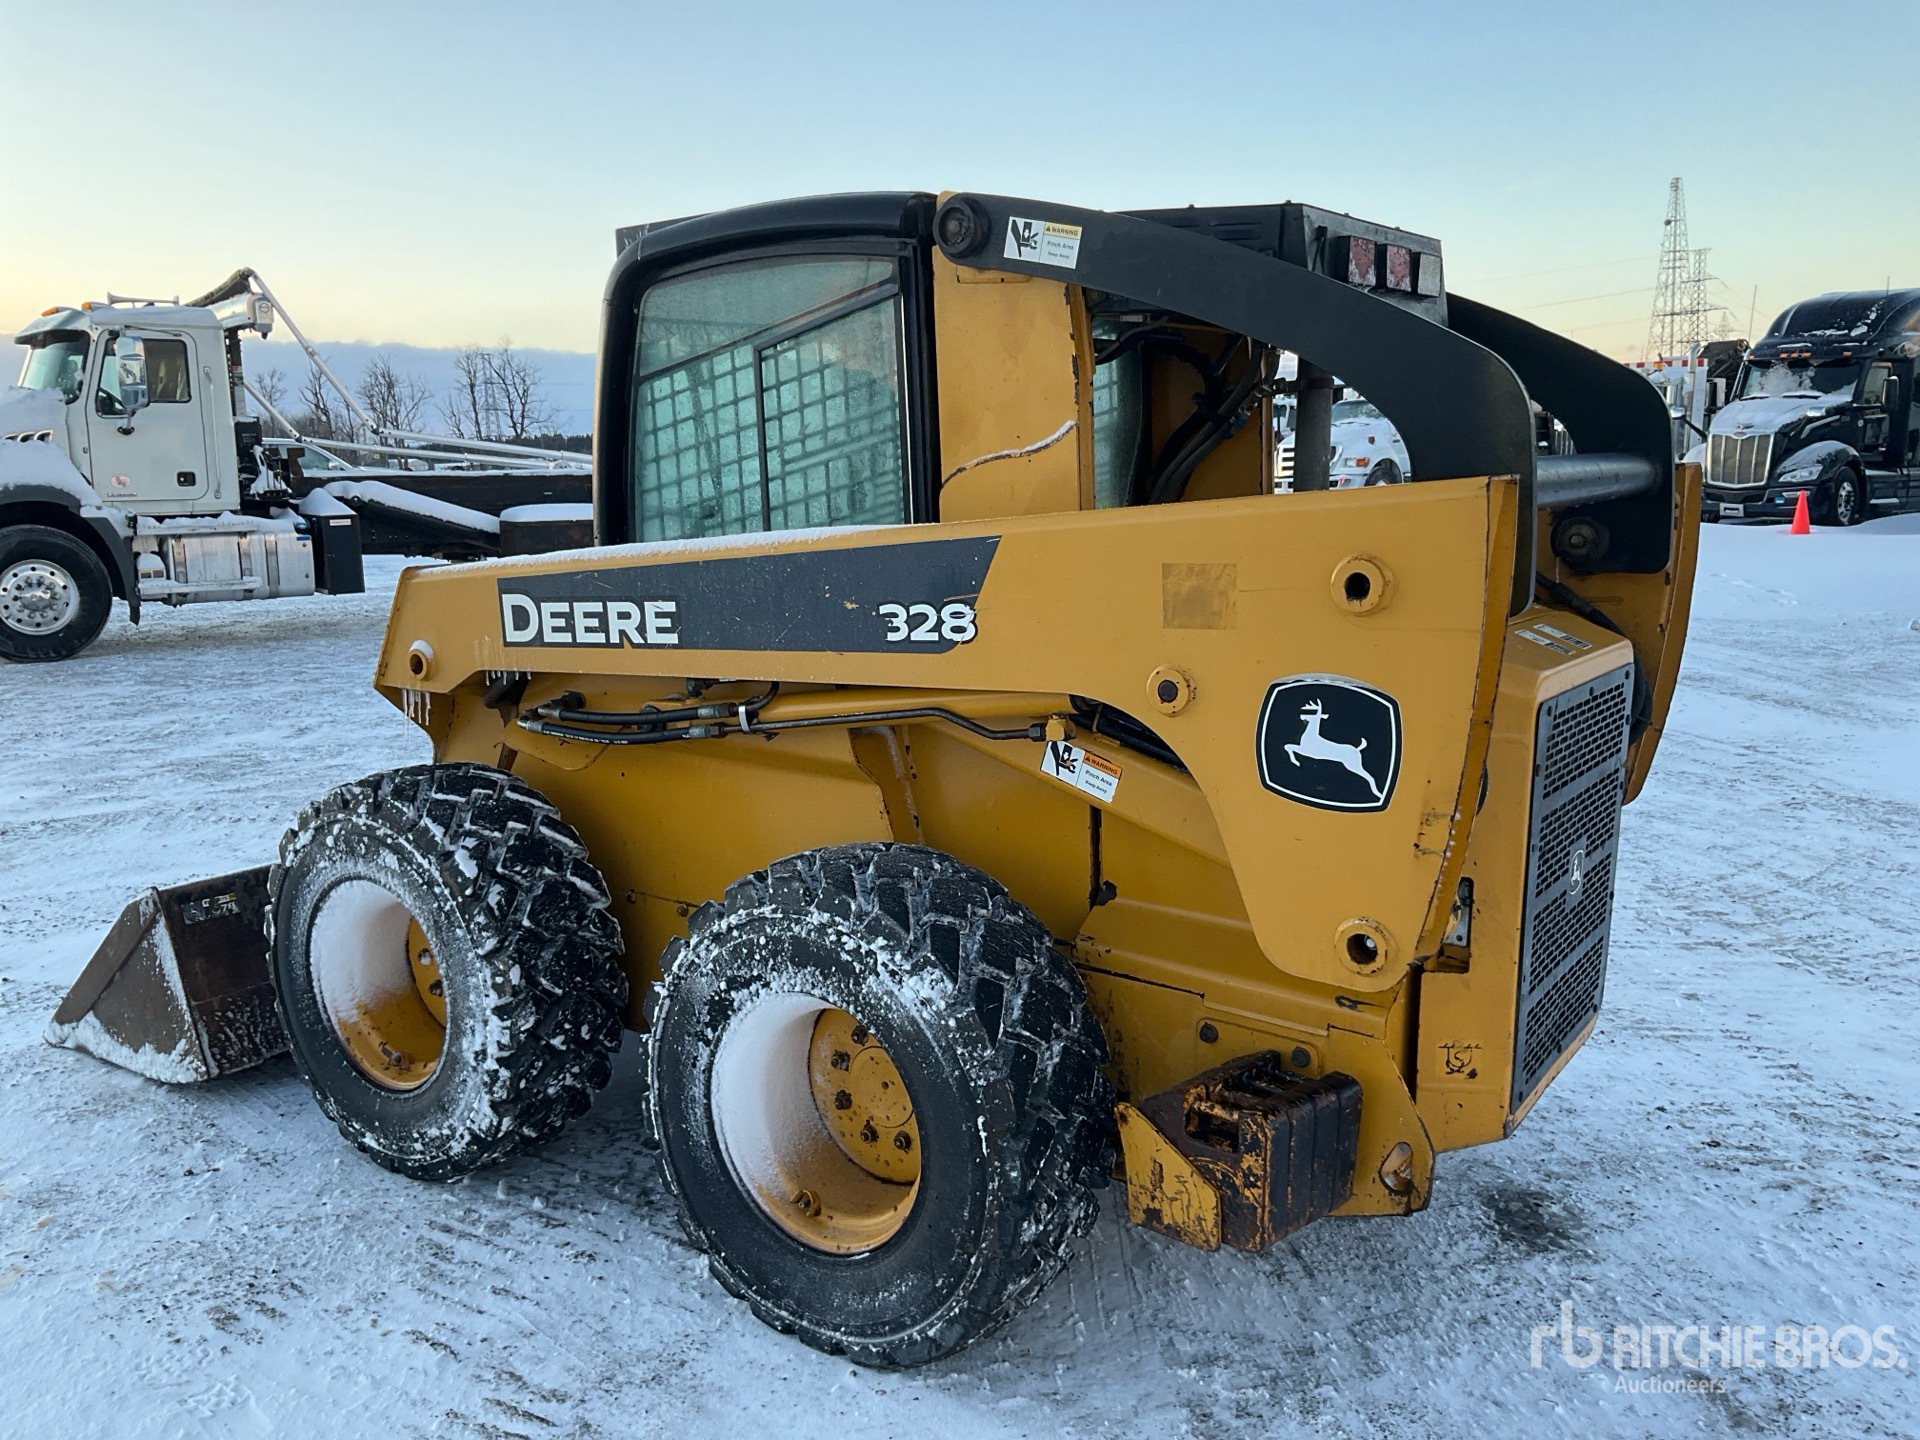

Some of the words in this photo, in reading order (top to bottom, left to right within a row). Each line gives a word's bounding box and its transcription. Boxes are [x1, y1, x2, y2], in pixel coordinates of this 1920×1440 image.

[1052, 227, 1078, 236] WARNING
[1047, 240, 1062, 248] Pinch
[502, 593, 679, 644] DEERE
[878, 603, 977, 642] 328
[1091, 759, 1118, 775] WARNING
[1085, 769, 1100, 781] Pinch
[1100, 777, 1112, 787] Area
[1085, 780, 1096, 789] Keep
[1096, 785, 1108, 794] Away
